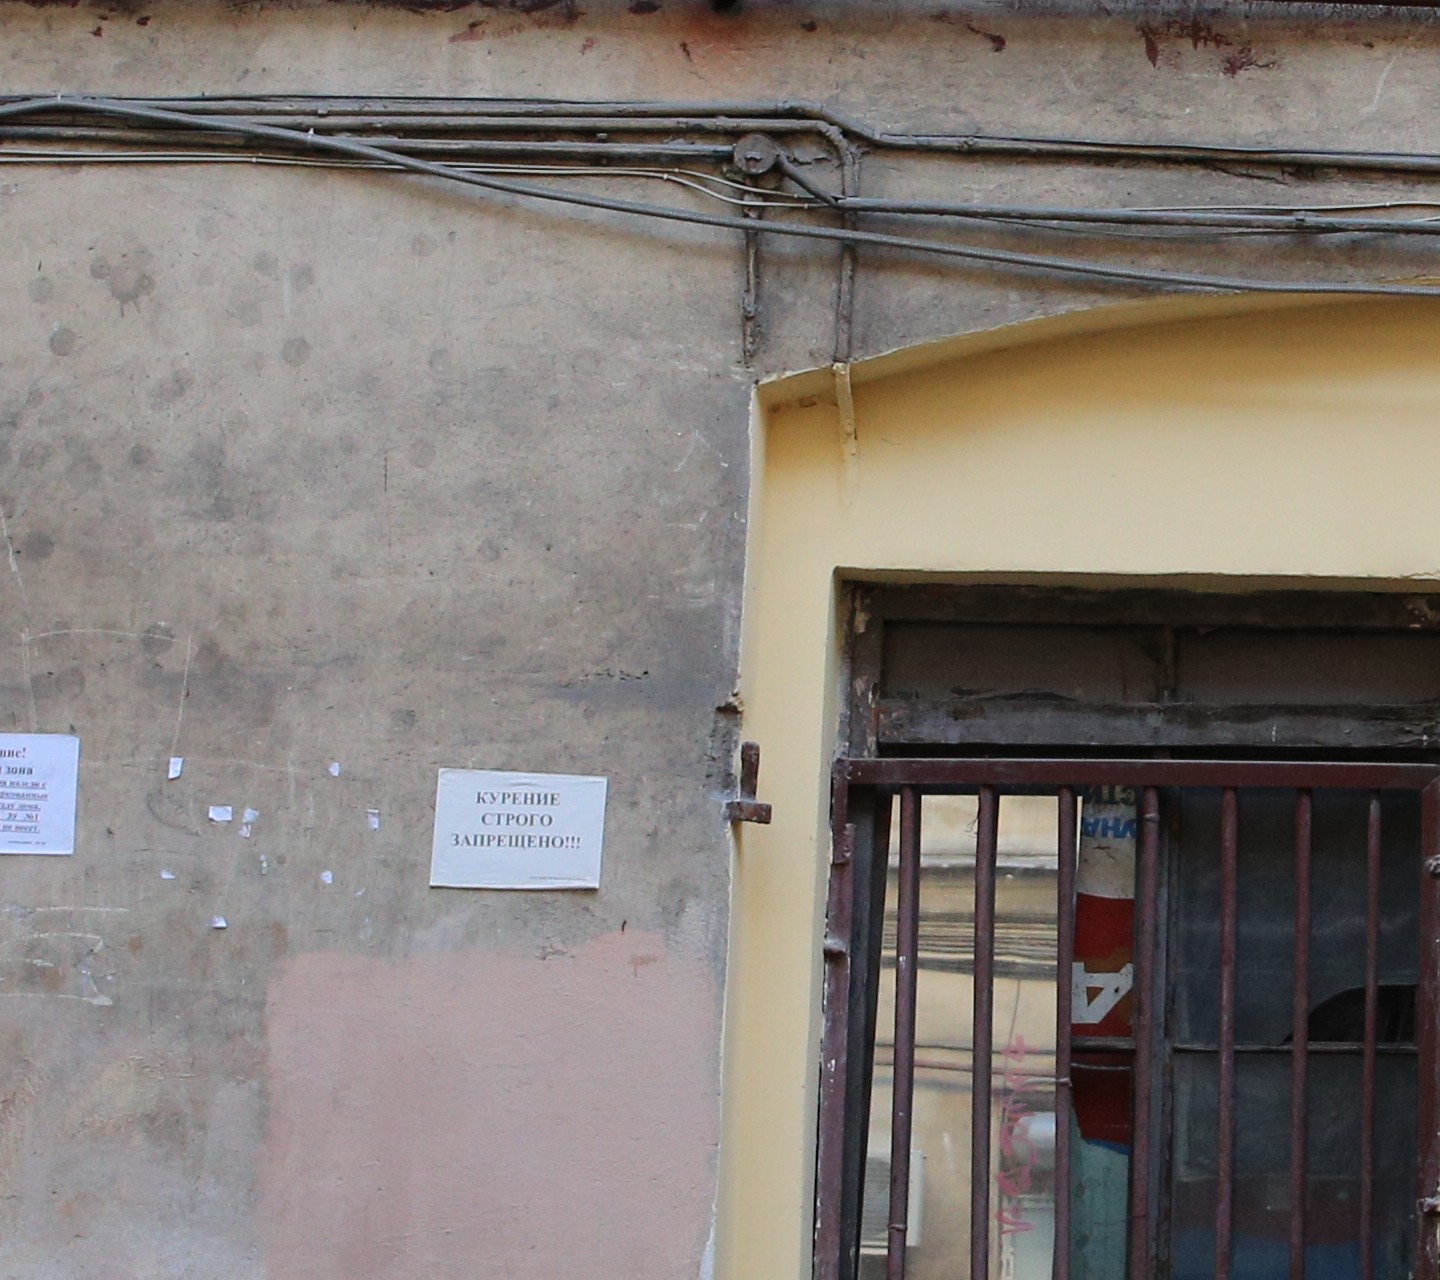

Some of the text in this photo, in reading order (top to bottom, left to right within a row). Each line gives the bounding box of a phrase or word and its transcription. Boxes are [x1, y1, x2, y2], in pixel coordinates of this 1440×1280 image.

[5, 764, 34, 776] зона
[475, 790, 561, 807] КУРЕНИЕ
[481, 811, 553, 828] СТРОГО
[450, 832, 581, 850] ЗАПРЕЩЕНО!!!
